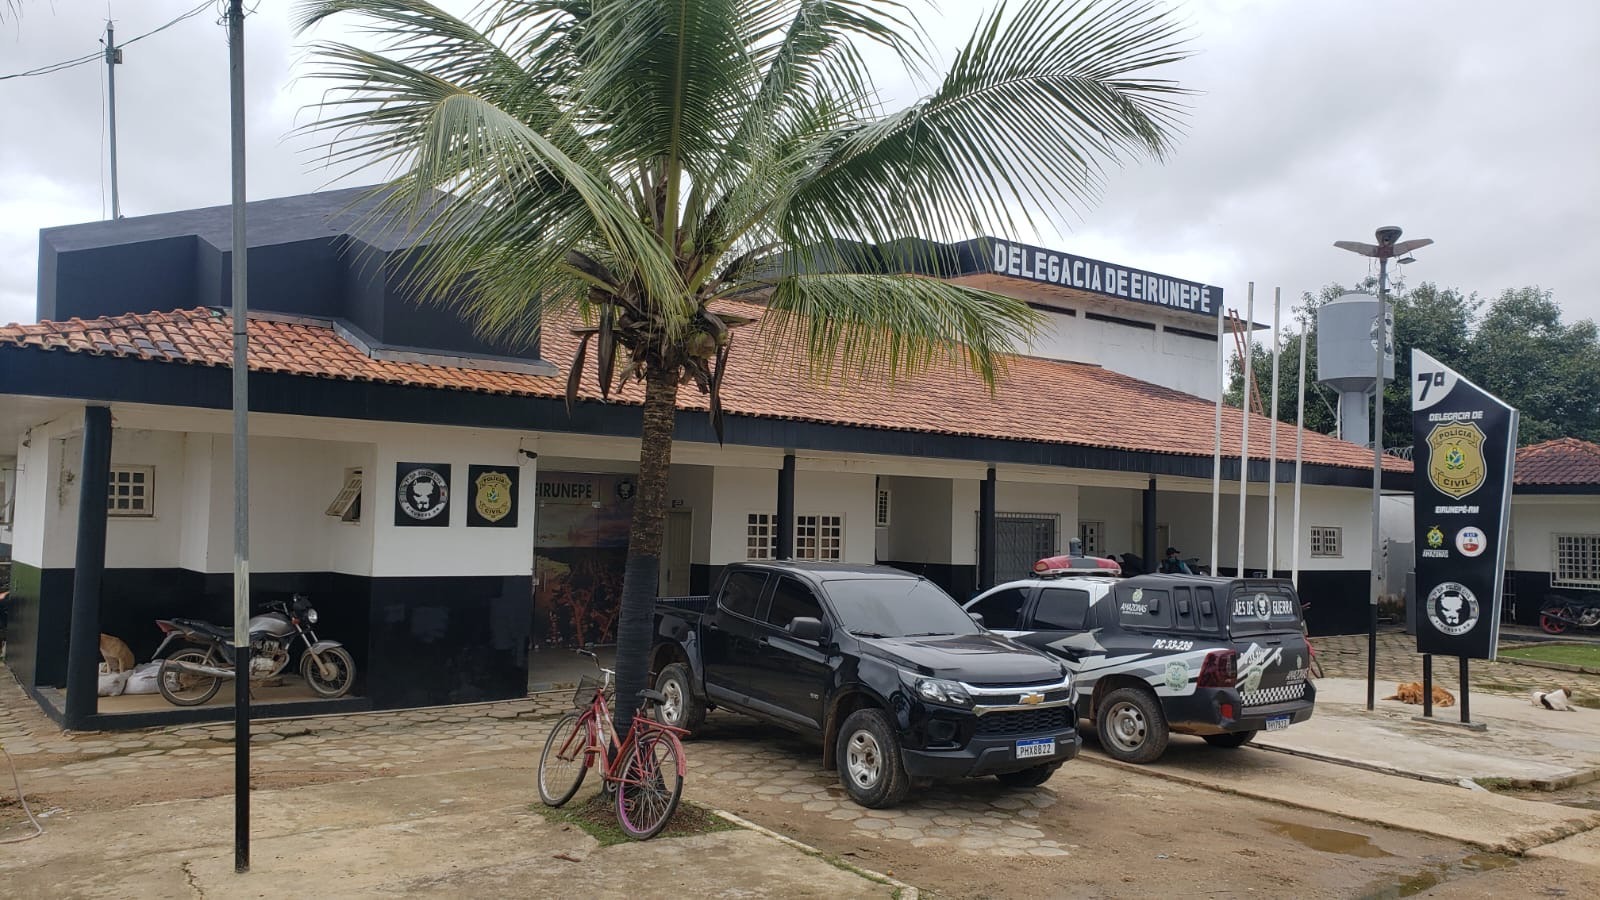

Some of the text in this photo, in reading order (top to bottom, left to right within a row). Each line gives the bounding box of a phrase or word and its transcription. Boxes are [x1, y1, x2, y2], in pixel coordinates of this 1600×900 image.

[994, 243, 1210, 313] DELEGACIA DE EIRUNEPÉ
[1418, 372, 1445, 401] 7ª
[1428, 410, 1484, 421] DELEGACIA DE
[1439, 428, 1472, 439] POLÍCIA
[1443, 478, 1472, 487] CIVIL
[1120, 602, 1148, 613] AMAZONAS
[1246, 600, 1254, 615] DE
[1272, 600, 1293, 615] GUERRA
[1152, 639, 1166, 649] PC
[1019, 743, 1051, 757] PHX8B22
